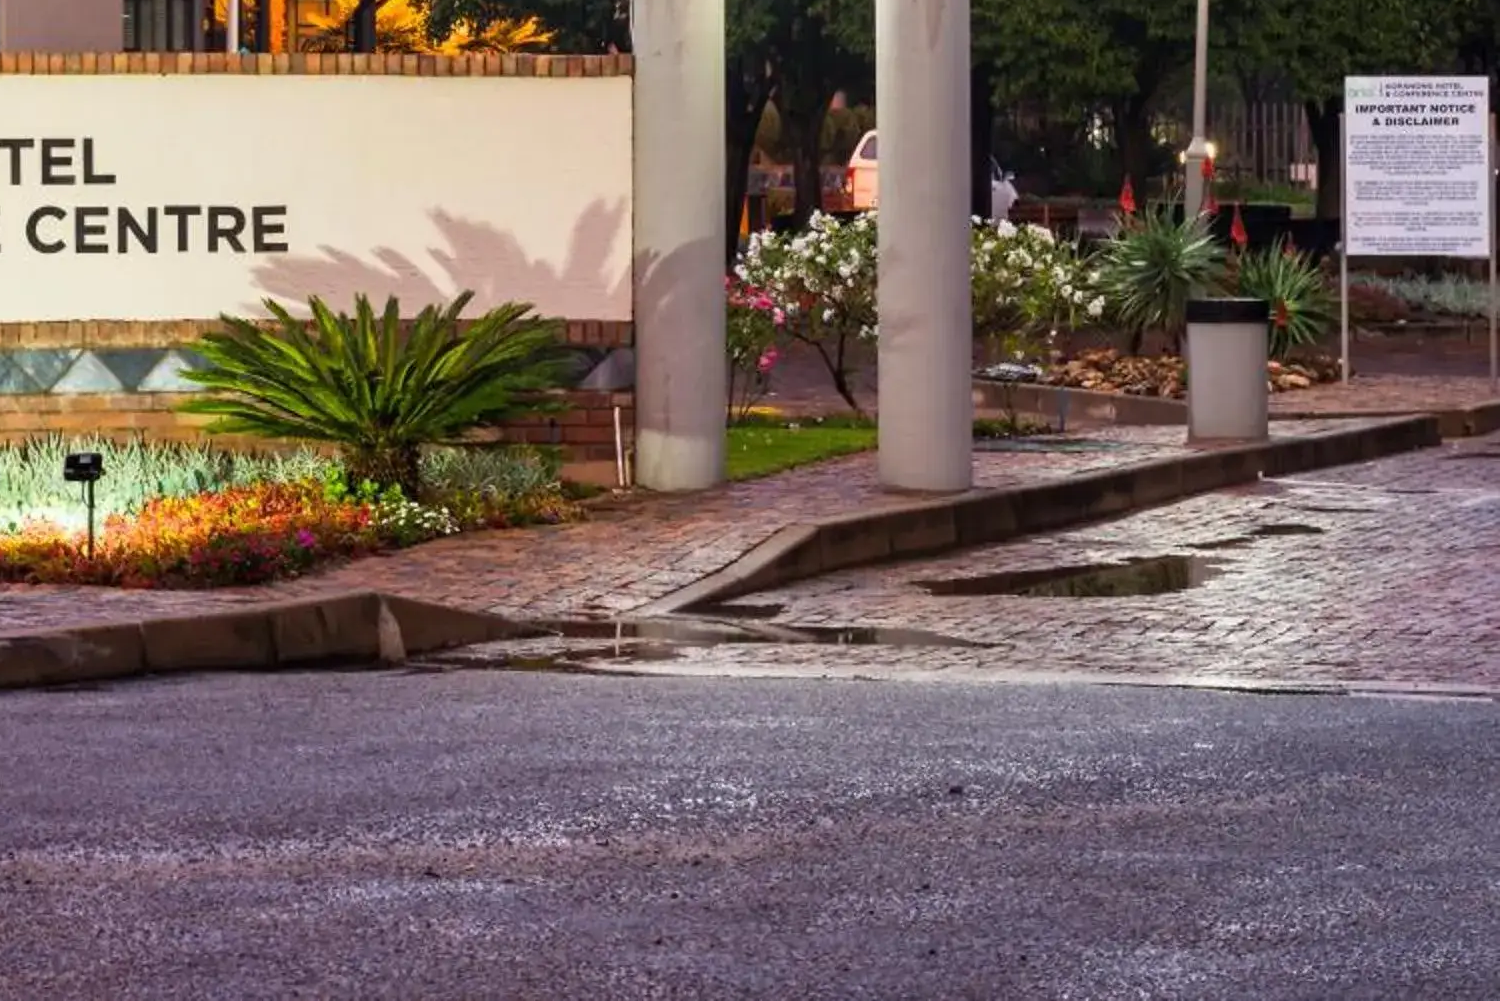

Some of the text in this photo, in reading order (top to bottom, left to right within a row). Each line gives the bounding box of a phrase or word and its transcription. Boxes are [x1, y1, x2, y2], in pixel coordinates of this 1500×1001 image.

[1355, 104, 1476, 114] IMPORTANT NOTICE
[1372, 116, 1460, 126] & DISCLAIMER
[25, 205, 289, 254] CENTRE
